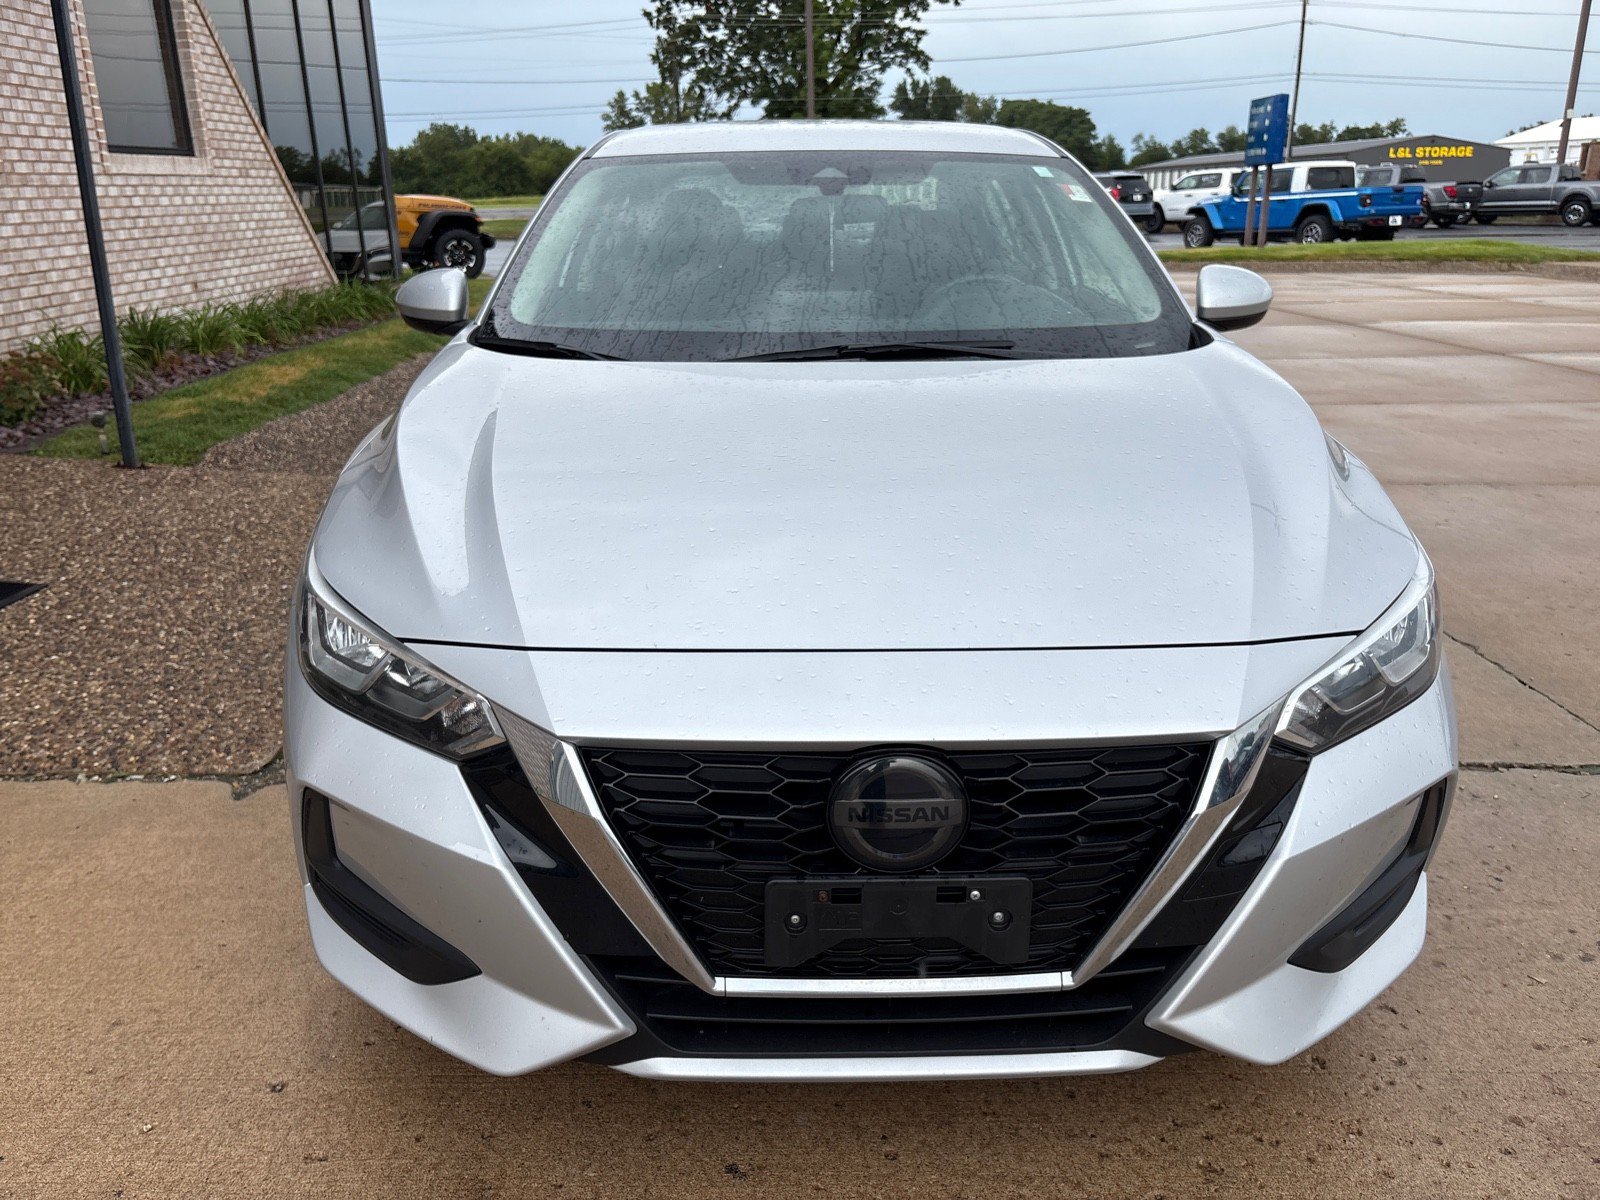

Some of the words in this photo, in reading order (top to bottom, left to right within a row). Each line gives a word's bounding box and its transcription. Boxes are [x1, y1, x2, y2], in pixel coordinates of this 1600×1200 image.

[1389, 147, 1412, 158] L&L
[1415, 146, 1474, 158] STORAGE
[848, 806, 949, 823] NISSAN
